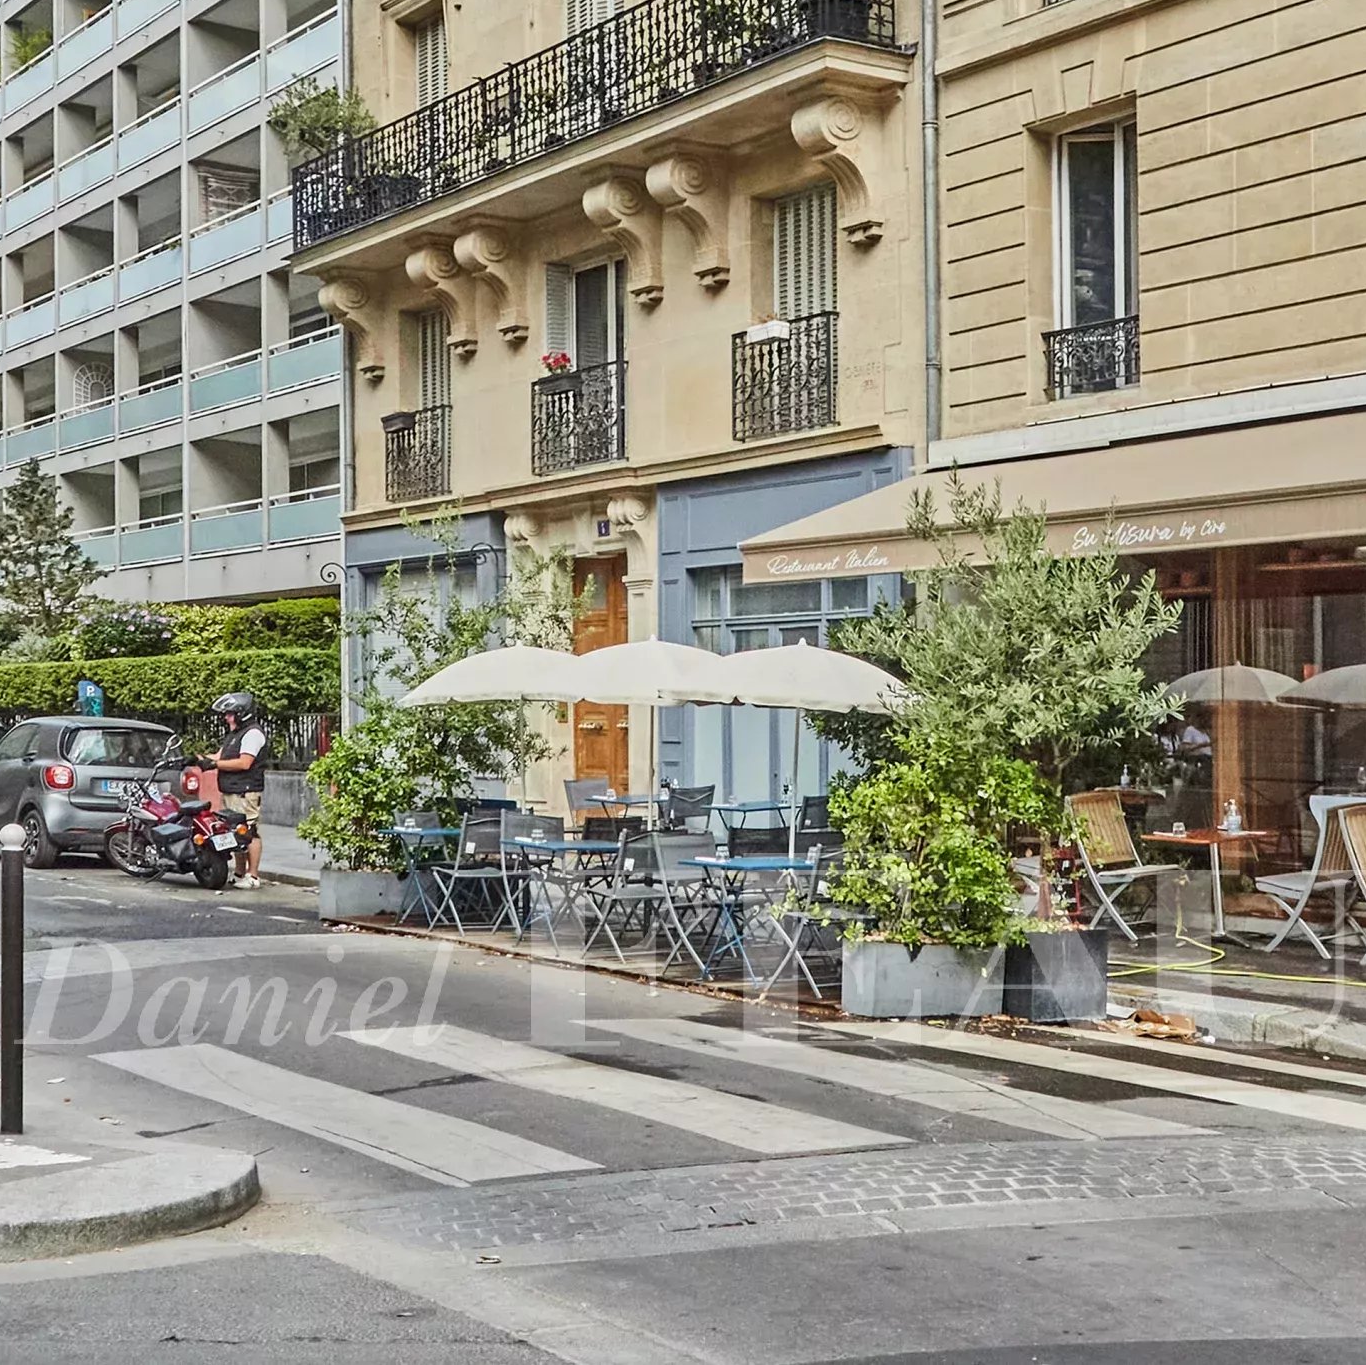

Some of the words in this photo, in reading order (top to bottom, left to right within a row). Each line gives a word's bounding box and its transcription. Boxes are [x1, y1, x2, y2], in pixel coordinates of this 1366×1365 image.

[1073, 527, 1098, 550] Su
[1179, 520, 1195, 540] by
[767, 555, 840, 574] Restaurant
[844, 545, 889, 569] Italien
[86, 685, 95, 697] P
